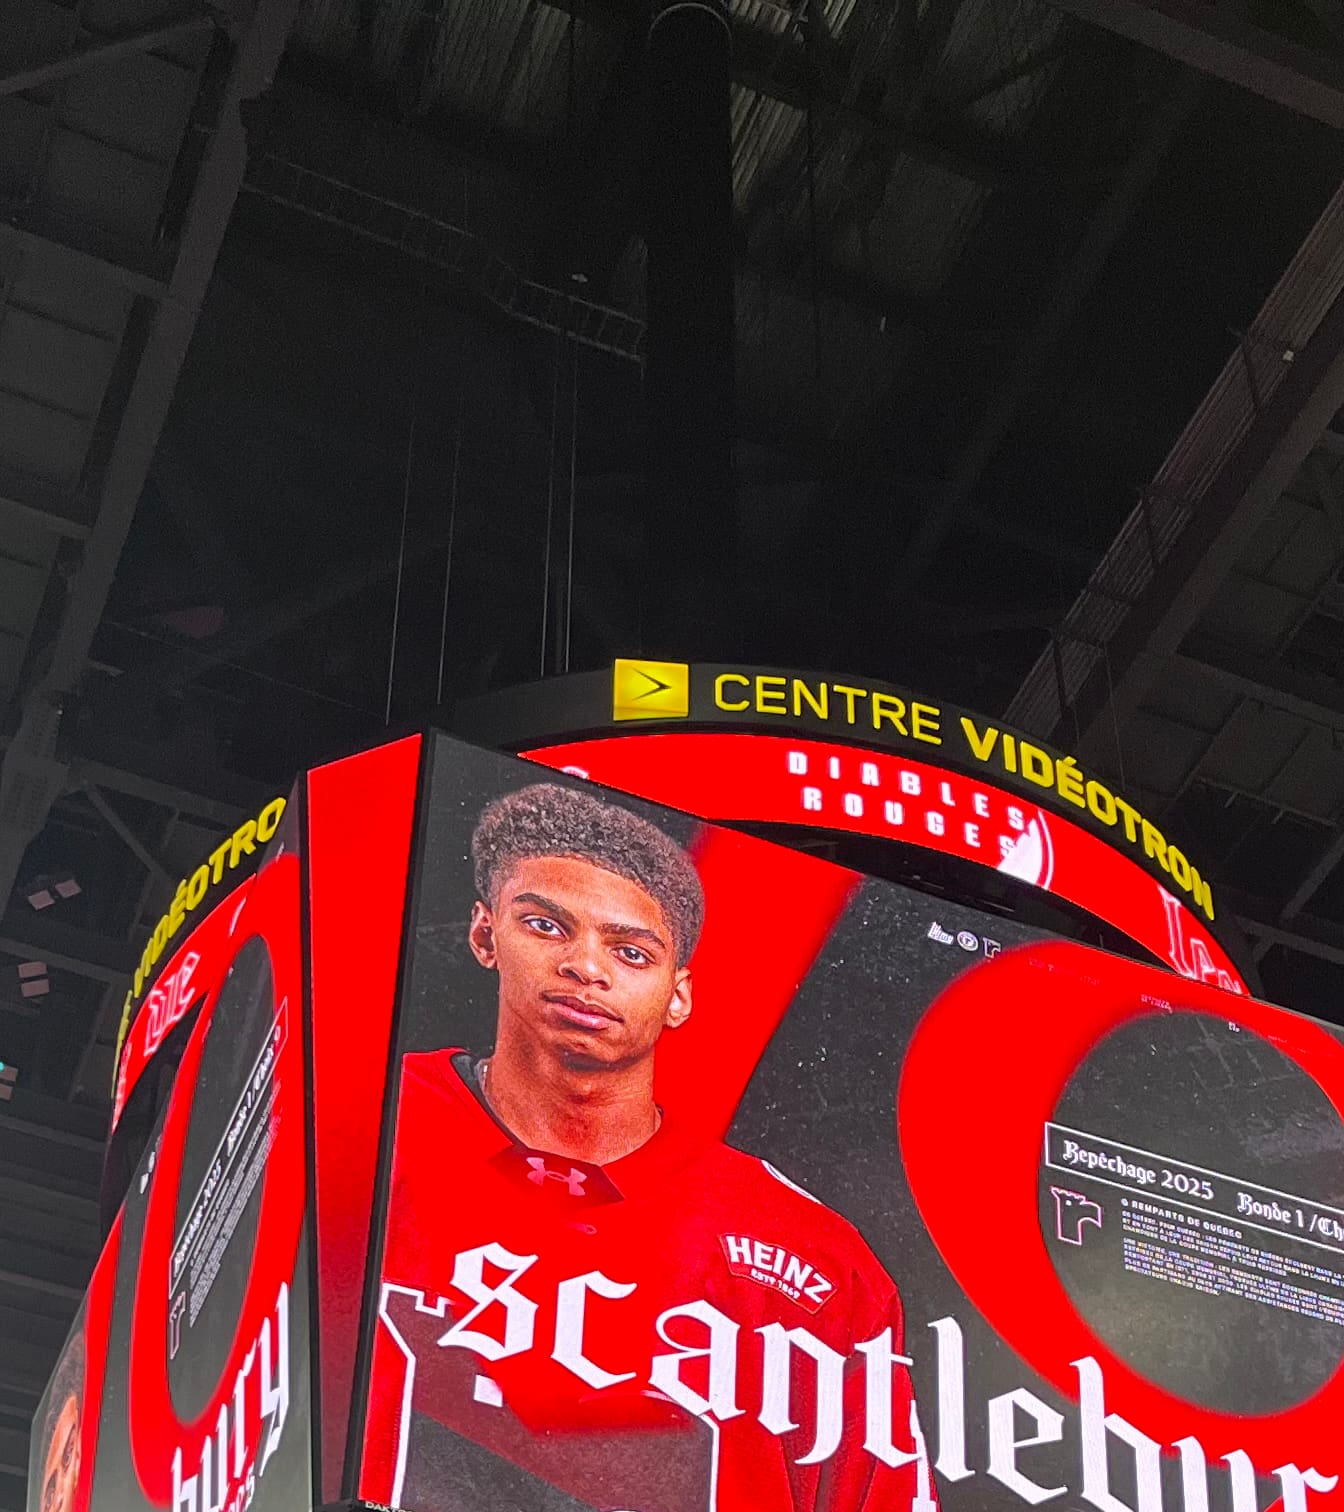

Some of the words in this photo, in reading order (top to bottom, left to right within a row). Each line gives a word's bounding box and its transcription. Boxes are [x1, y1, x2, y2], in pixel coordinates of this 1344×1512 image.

[713, 672, 942, 747] CENTRE
[959, 714, 1216, 922] VIDÉOTRON
[787, 749, 1028, 833] DIABLES
[802, 786, 1018, 860] ROUGES
[133, 796, 287, 998] VIDÉOTRO
[1062, 1138, 1157, 1185] Repêchage
[1161, 1169, 1215, 1202] 2025
[1236, 1192, 1293, 1228] Ronde
[1187, 1215, 1201, 1228] DE
[725, 1235, 833, 1304] HEINZ
